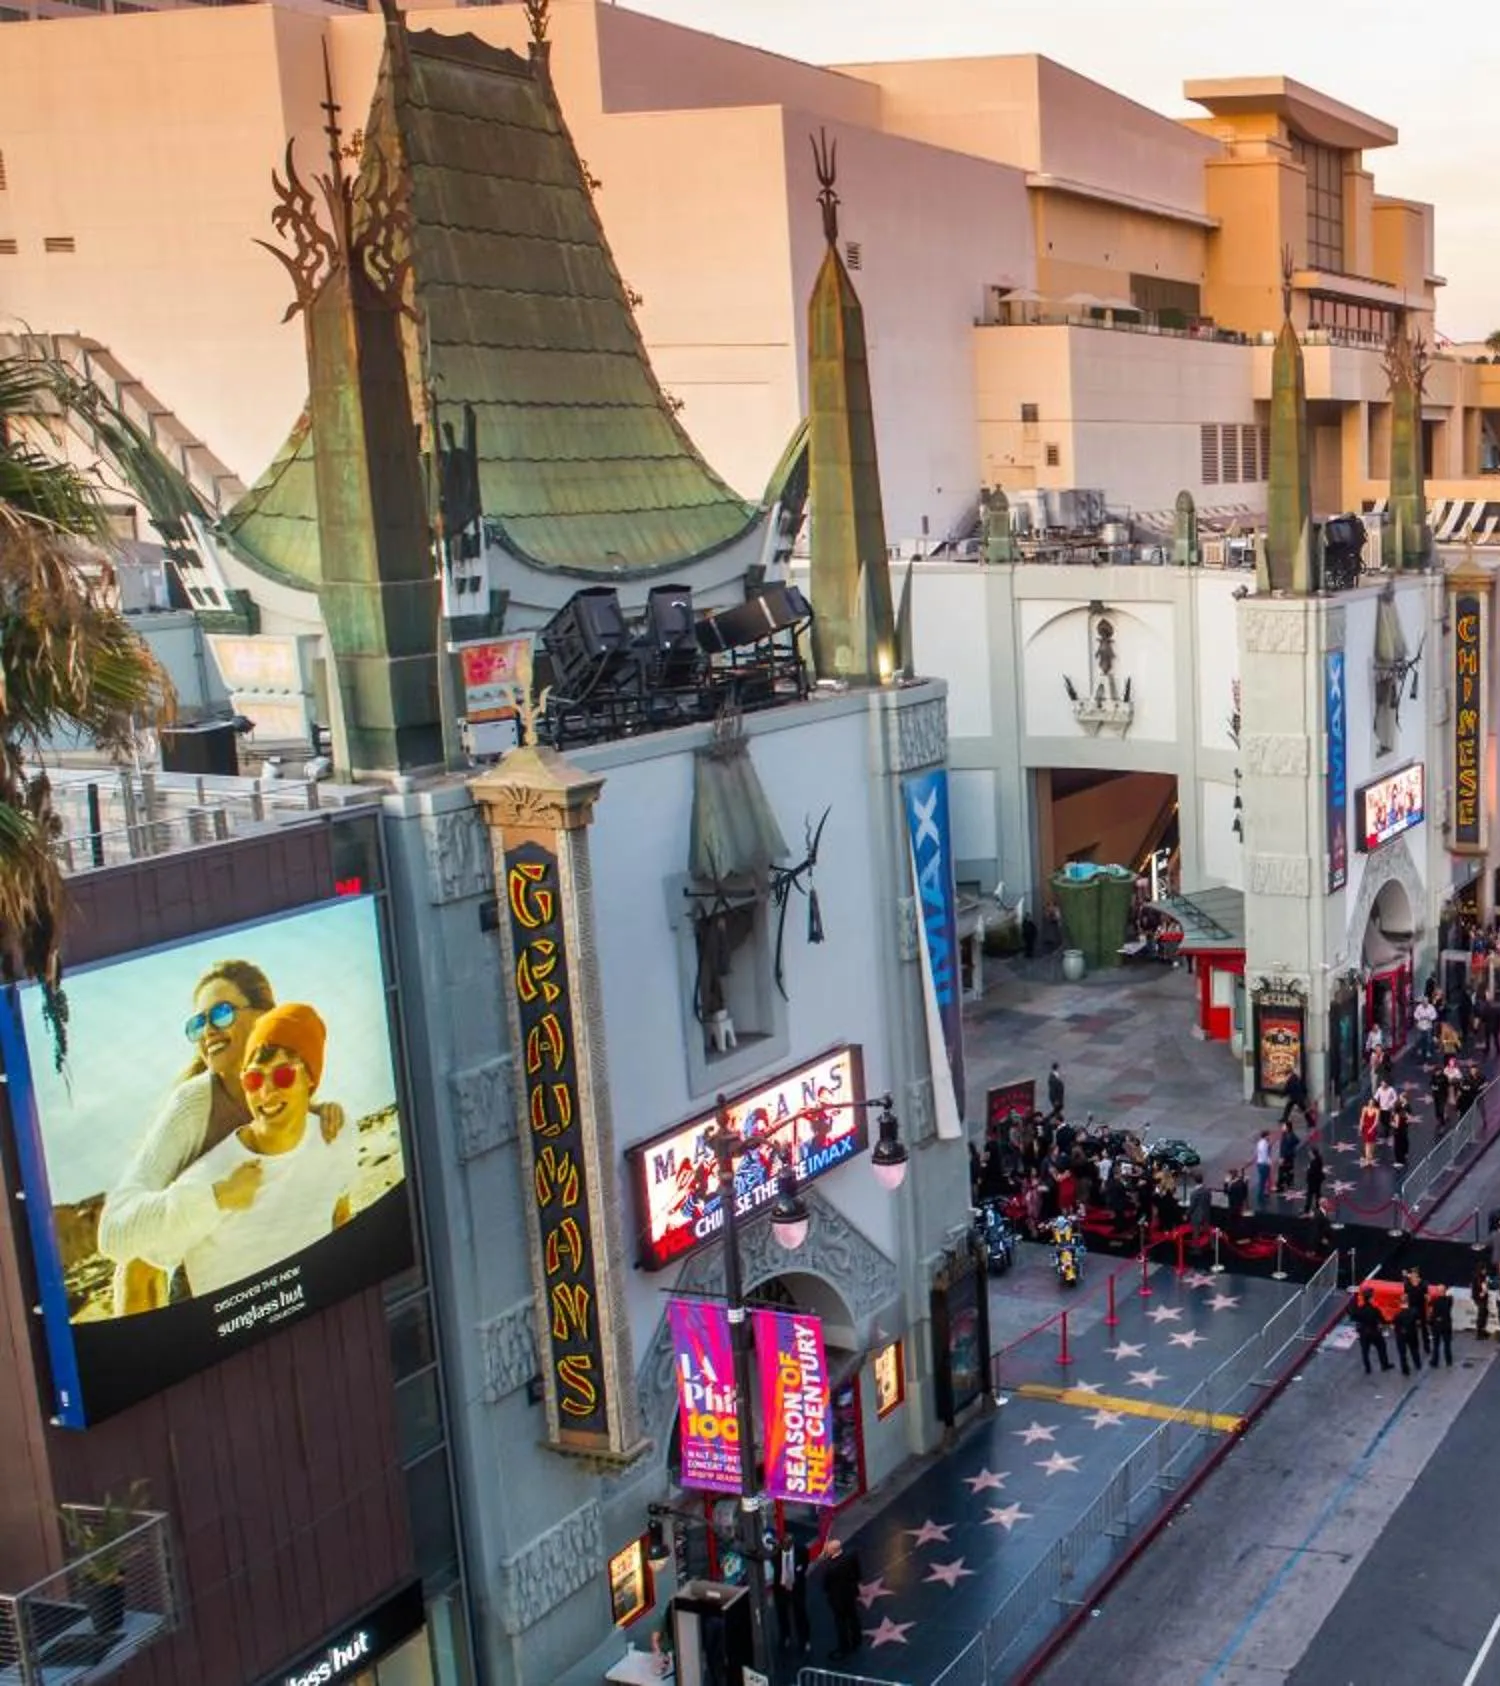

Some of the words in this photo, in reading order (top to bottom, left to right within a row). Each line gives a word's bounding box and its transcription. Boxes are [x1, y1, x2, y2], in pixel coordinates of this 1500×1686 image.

[1457, 614, 1477, 827] CHINESE
[913, 785, 953, 1007] IMAX
[509, 862, 598, 1418] GRAUMANS
[808, 1135, 853, 1175] IMAX
[213, 1284, 261, 1313] DISCOVER
[261, 1276, 278, 1292] THE
[217, 1299, 279, 1337] sunglass
[279, 1283, 304, 1308] hut
[680, 1353, 718, 1382] LA
[779, 1351, 801, 1386] OF
[794, 1323, 825, 1437] CENTURY
[687, 1413, 739, 1441] 100
[784, 1393, 806, 1493] SEASON
[806, 1437, 828, 1495] THE
[330, 1631, 369, 1673] hut
